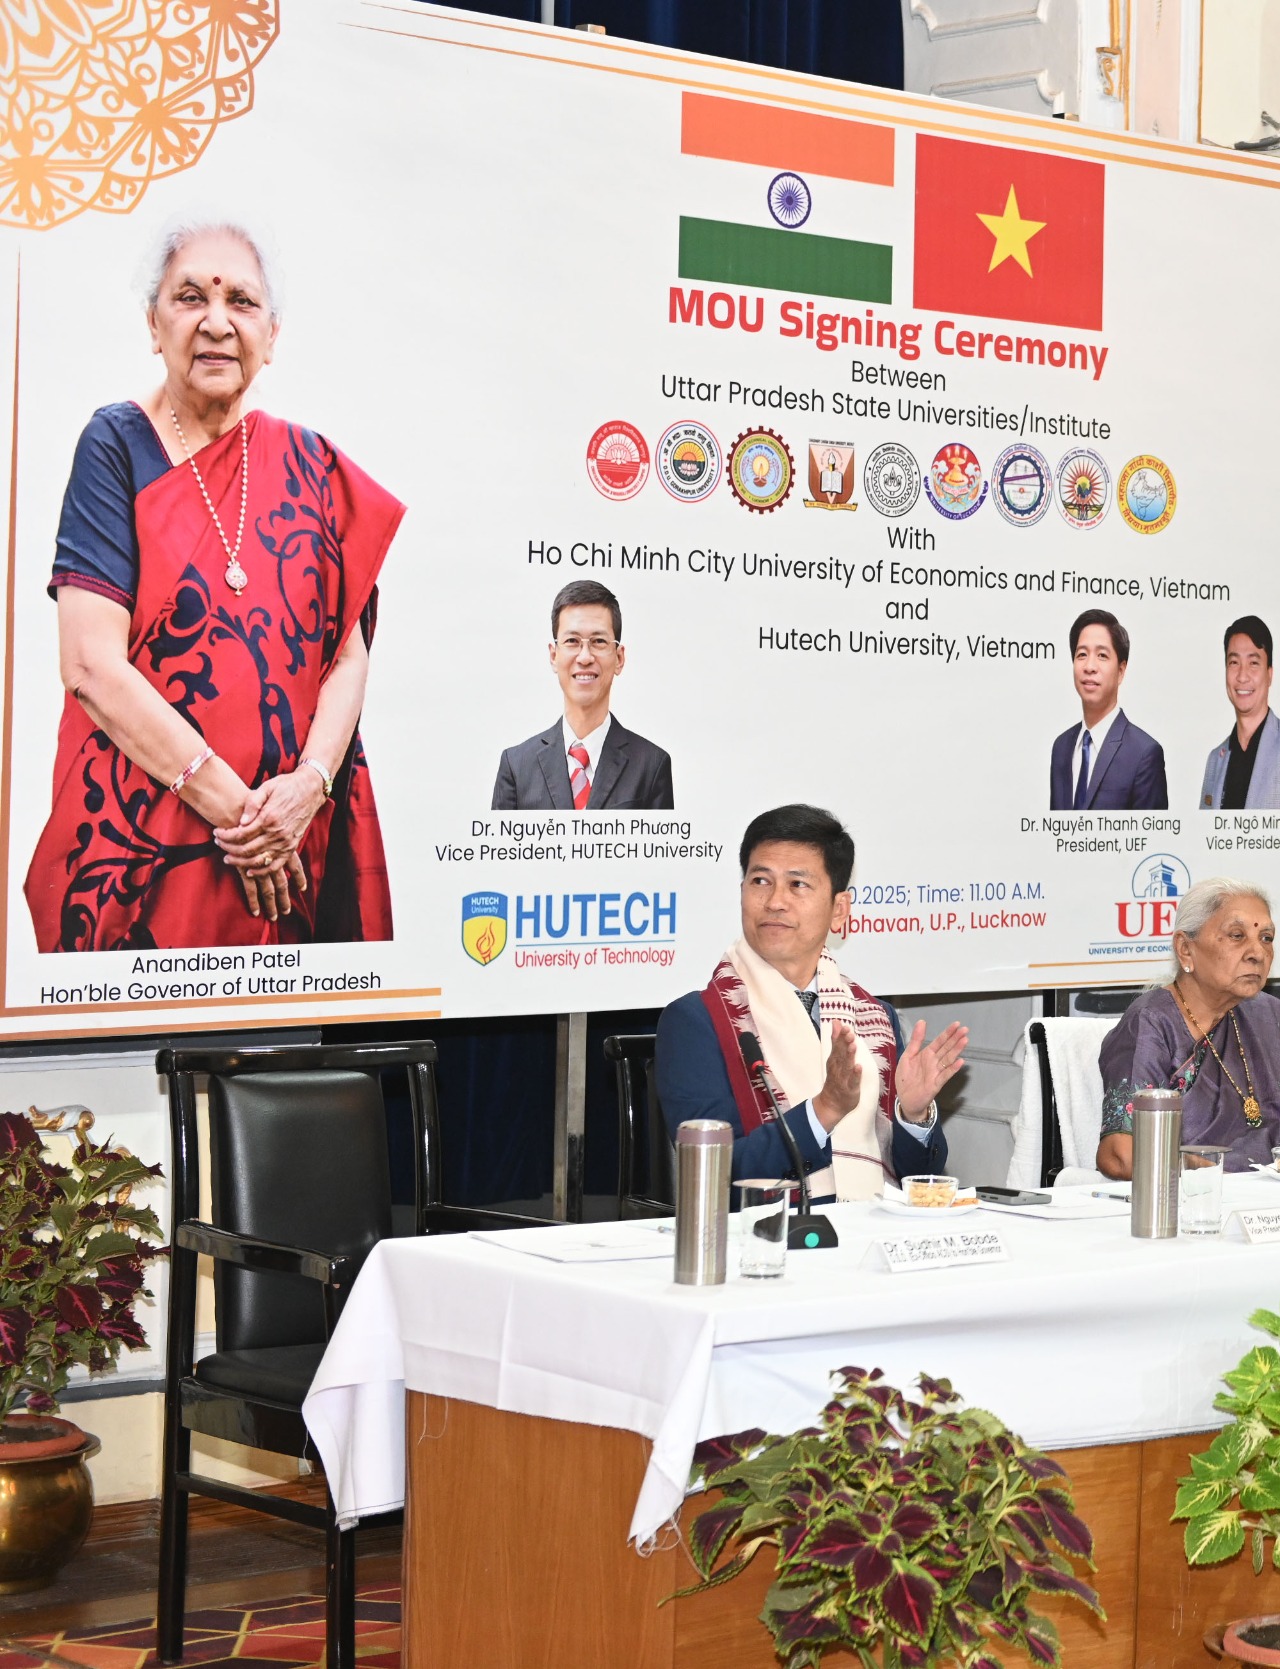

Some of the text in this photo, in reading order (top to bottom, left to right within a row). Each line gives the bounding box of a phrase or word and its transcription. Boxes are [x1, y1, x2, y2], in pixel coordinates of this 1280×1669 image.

[669, 287, 1108, 381] MOU Signing Ceremony
[852, 360, 945, 391] Between
[662, 375, 1110, 439] Uttar Pradesh State Universities/Institute
[887, 527, 935, 550] With
[529, 541, 1229, 601] Ho Chi Minh City University of Economics and Finance, Vietnam
[886, 598, 928, 620] and
[760, 627, 1055, 663] Hutech University, Vietnam
[472, 819, 690, 841] Dr. Nguyễn Thanh Phương
[1021, 814, 1180, 836] Dr. Nguyễn Thanh Giang
[1215, 817, 1230, 829] Dr.
[1235, 814, 1258, 834] Ngô
[435, 841, 723, 862] Vice President, HUTECH University
[1057, 837, 1147, 853] President, UEF
[1206, 836, 1232, 849] Vice
[471, 896, 499, 905] HUTECH
[847, 883, 1044, 907] 0.2025; Time: 11.00 A.M.
[516, 892, 676, 938] HUTECH
[931, 913, 964, 932] U.P.,
[971, 910, 1046, 929] Lucknow
[1114, 901, 1177, 937] UE
[132, 950, 300, 973] Anandiben Patel
[515, 948, 675, 969] University of Technology
[1089, 946, 1134, 955] UNIVERSITY
[41, 972, 380, 1003] Hon’ble Govenor of Uttar Pradesh
[1244, 1216, 1256, 1225] Dr.
